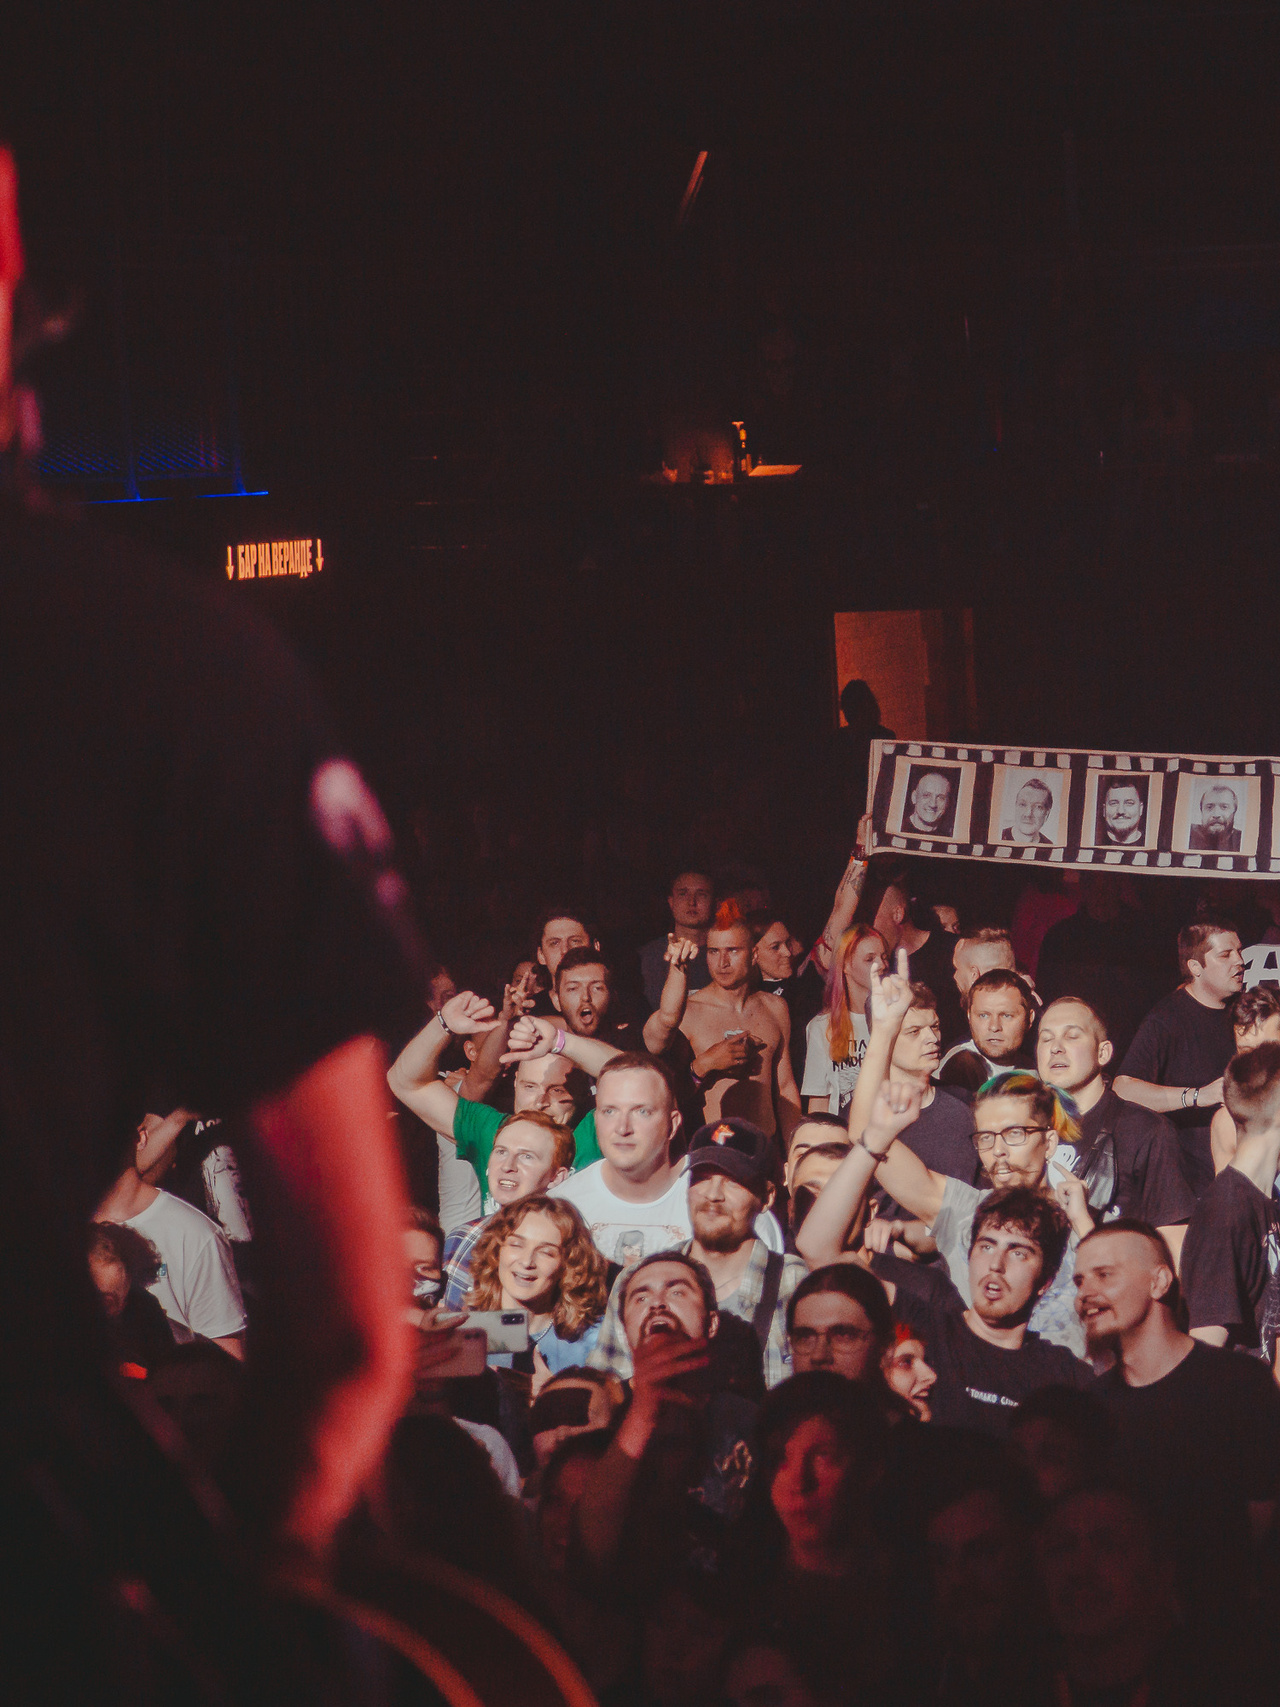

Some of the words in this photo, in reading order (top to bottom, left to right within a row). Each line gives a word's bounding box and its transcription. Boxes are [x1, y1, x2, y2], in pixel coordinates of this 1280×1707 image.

[237, 544, 257, 580] БАР
[258, 542, 272, 578] НА
[271, 539, 313, 578] ВЕРАНДЕ
